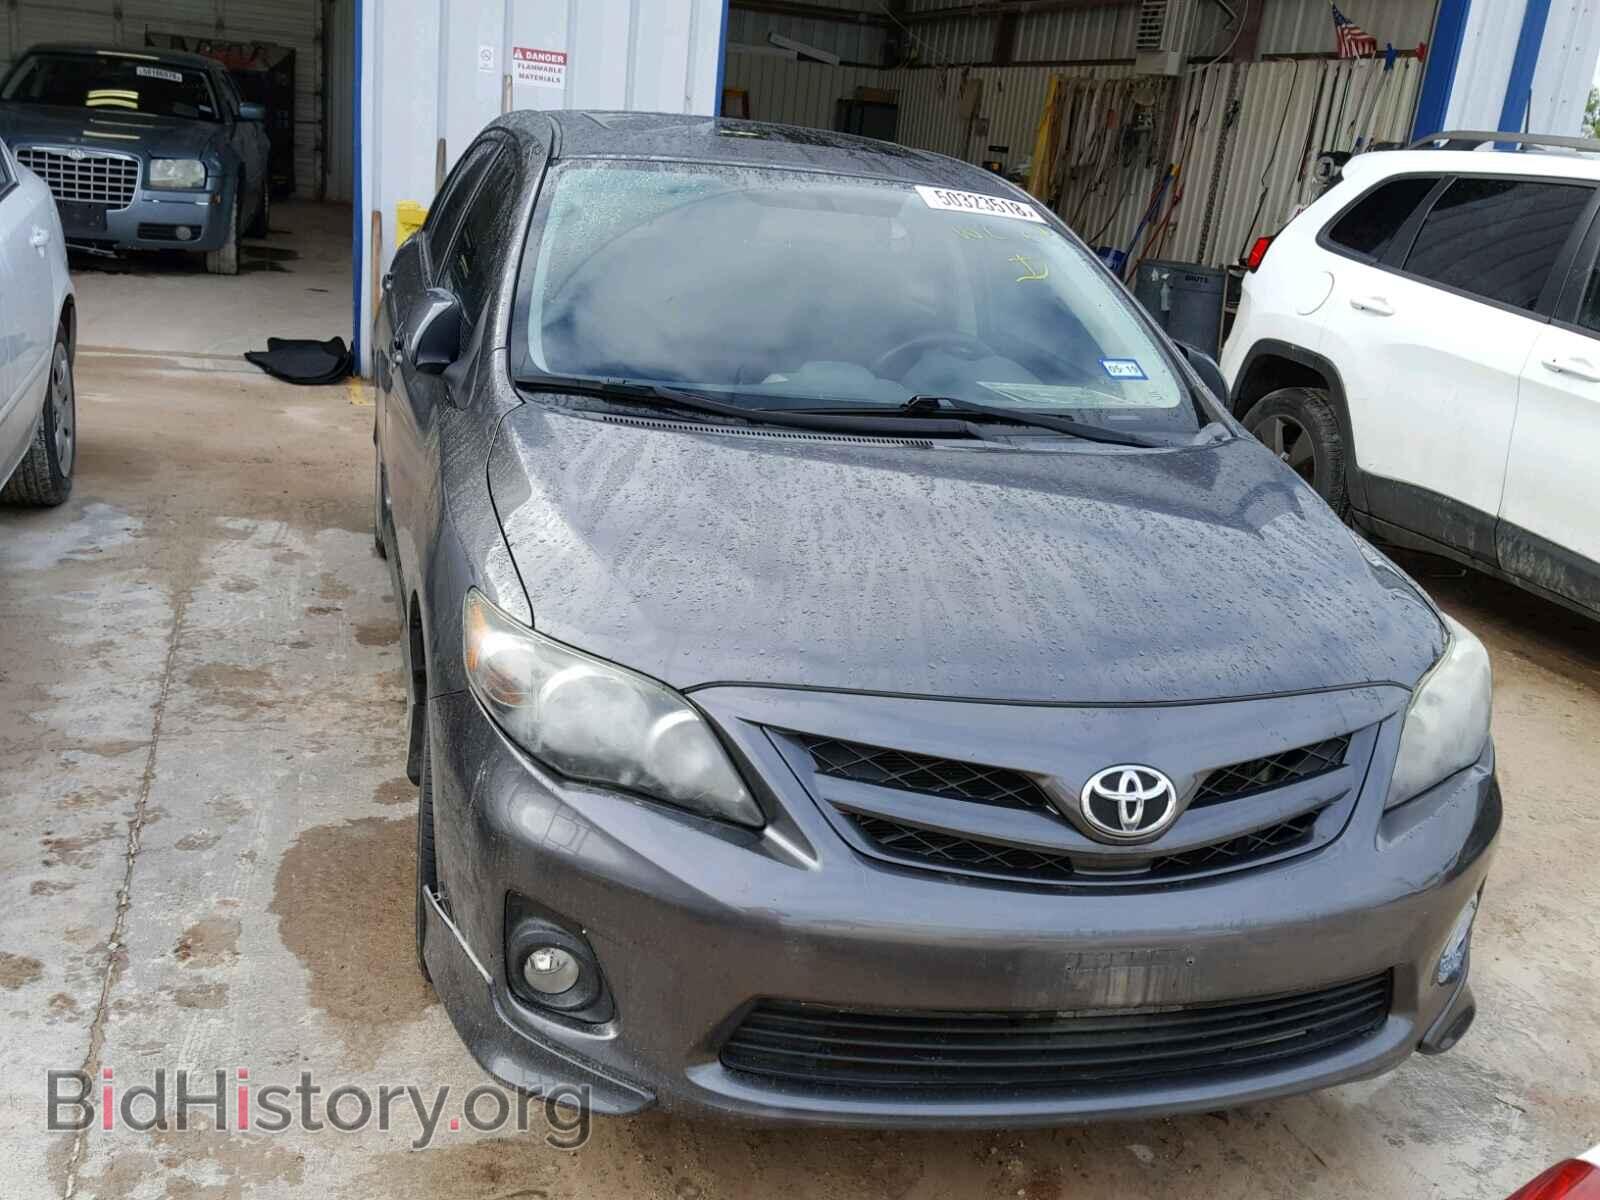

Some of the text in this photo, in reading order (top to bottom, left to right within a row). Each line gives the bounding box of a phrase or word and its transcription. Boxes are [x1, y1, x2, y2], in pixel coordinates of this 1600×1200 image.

[526, 51, 565, 64] DANGER
[517, 62, 562, 74] FLAMMABLE
[518, 72, 561, 83] MATERIALS
